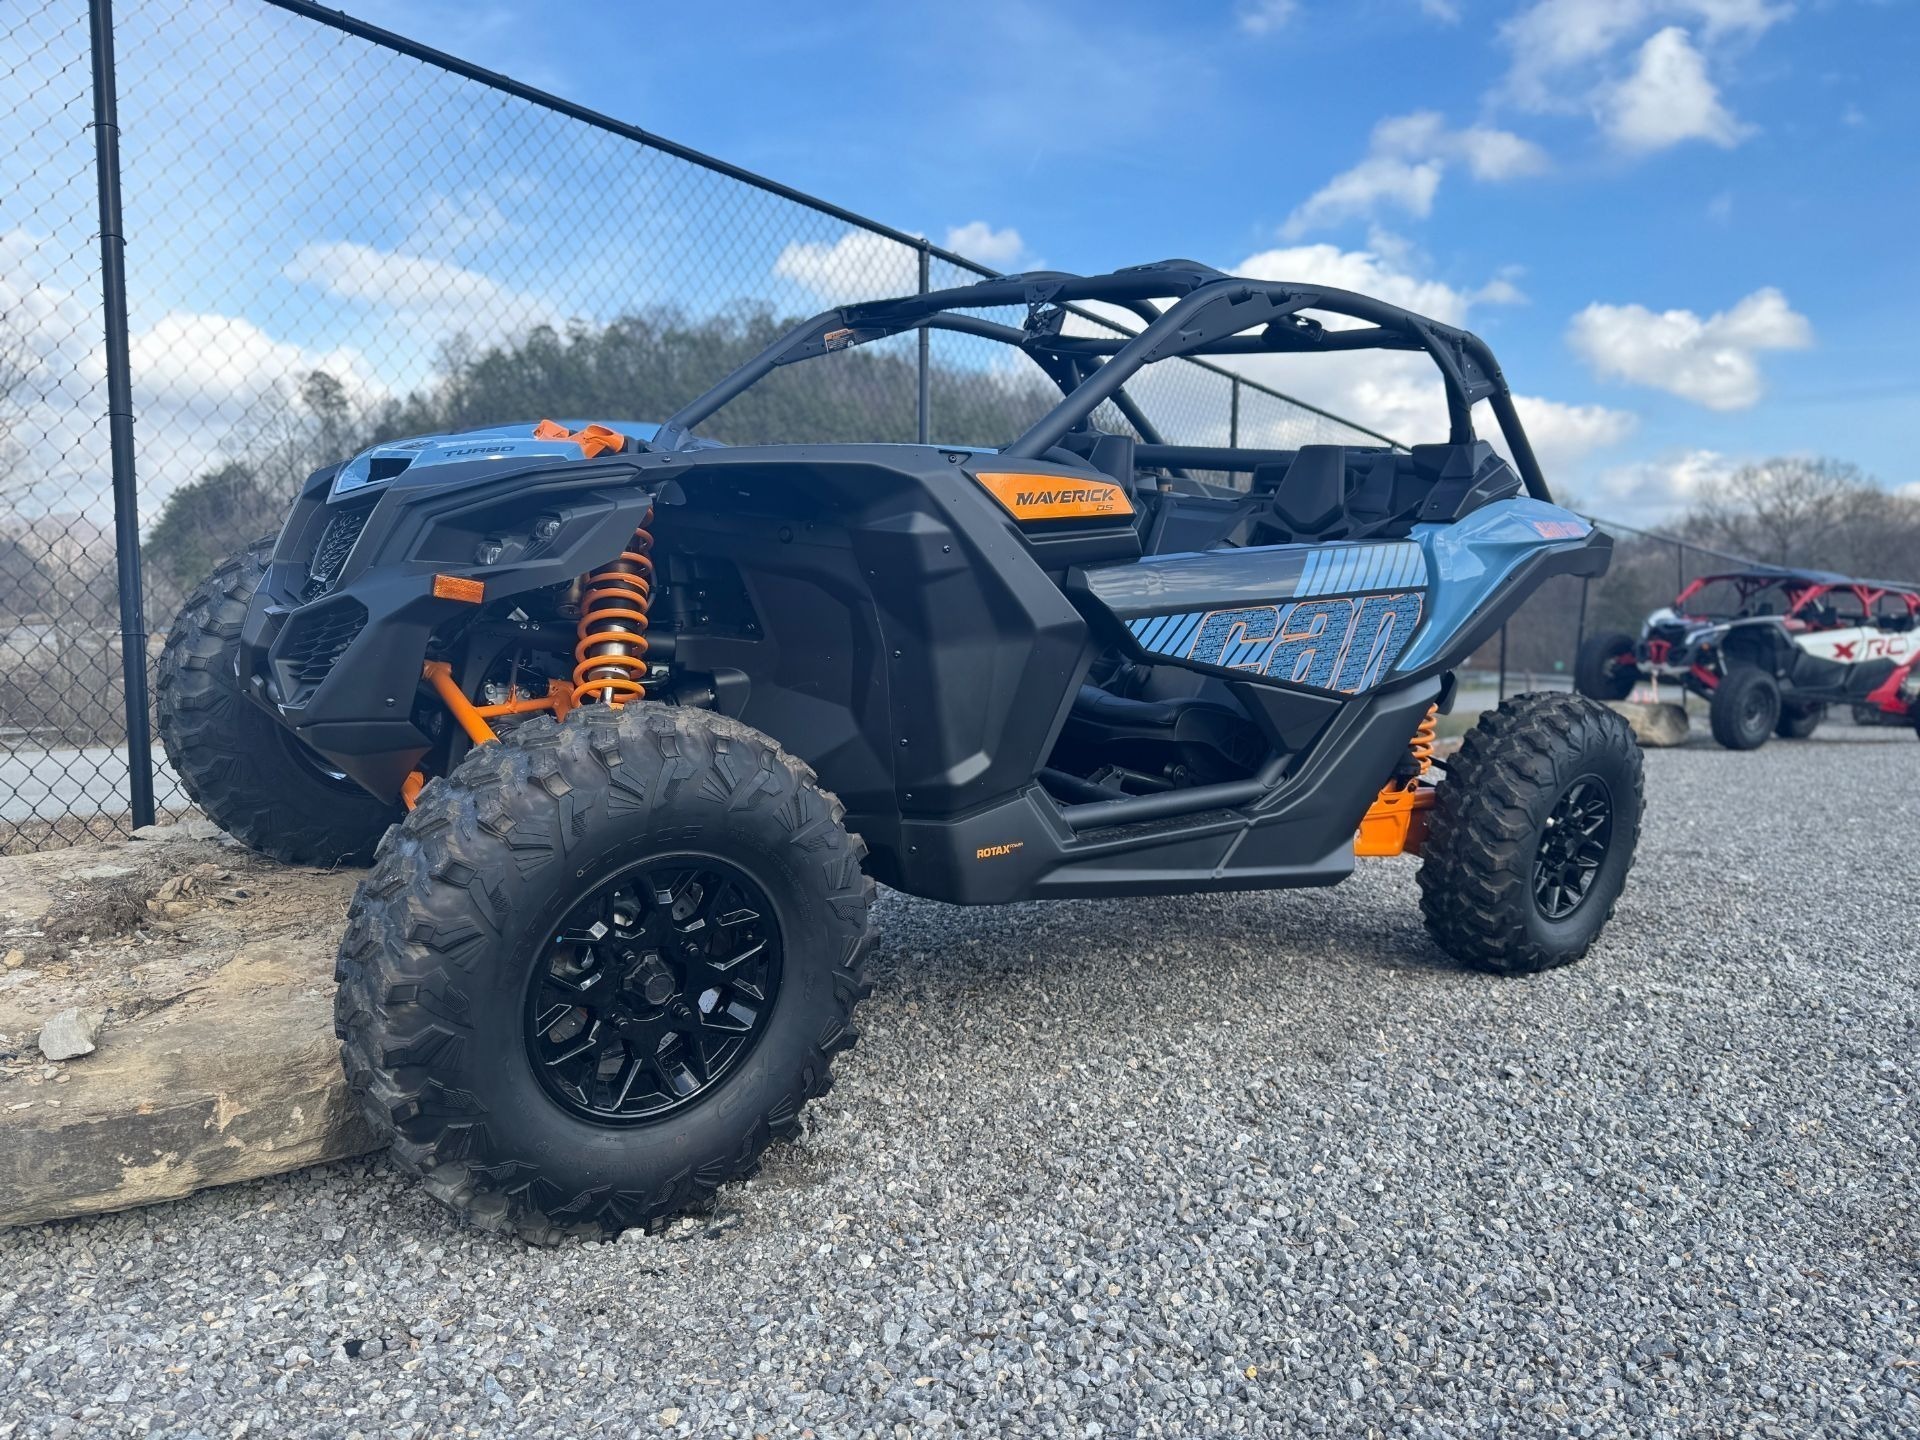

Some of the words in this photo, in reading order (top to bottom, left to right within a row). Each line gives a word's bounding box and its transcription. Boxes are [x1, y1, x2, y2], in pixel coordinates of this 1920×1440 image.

[445, 446, 515, 457] TURBO
[1016, 488, 1116, 505] MAVERICK
[976, 844, 1010, 859] ROTAX
